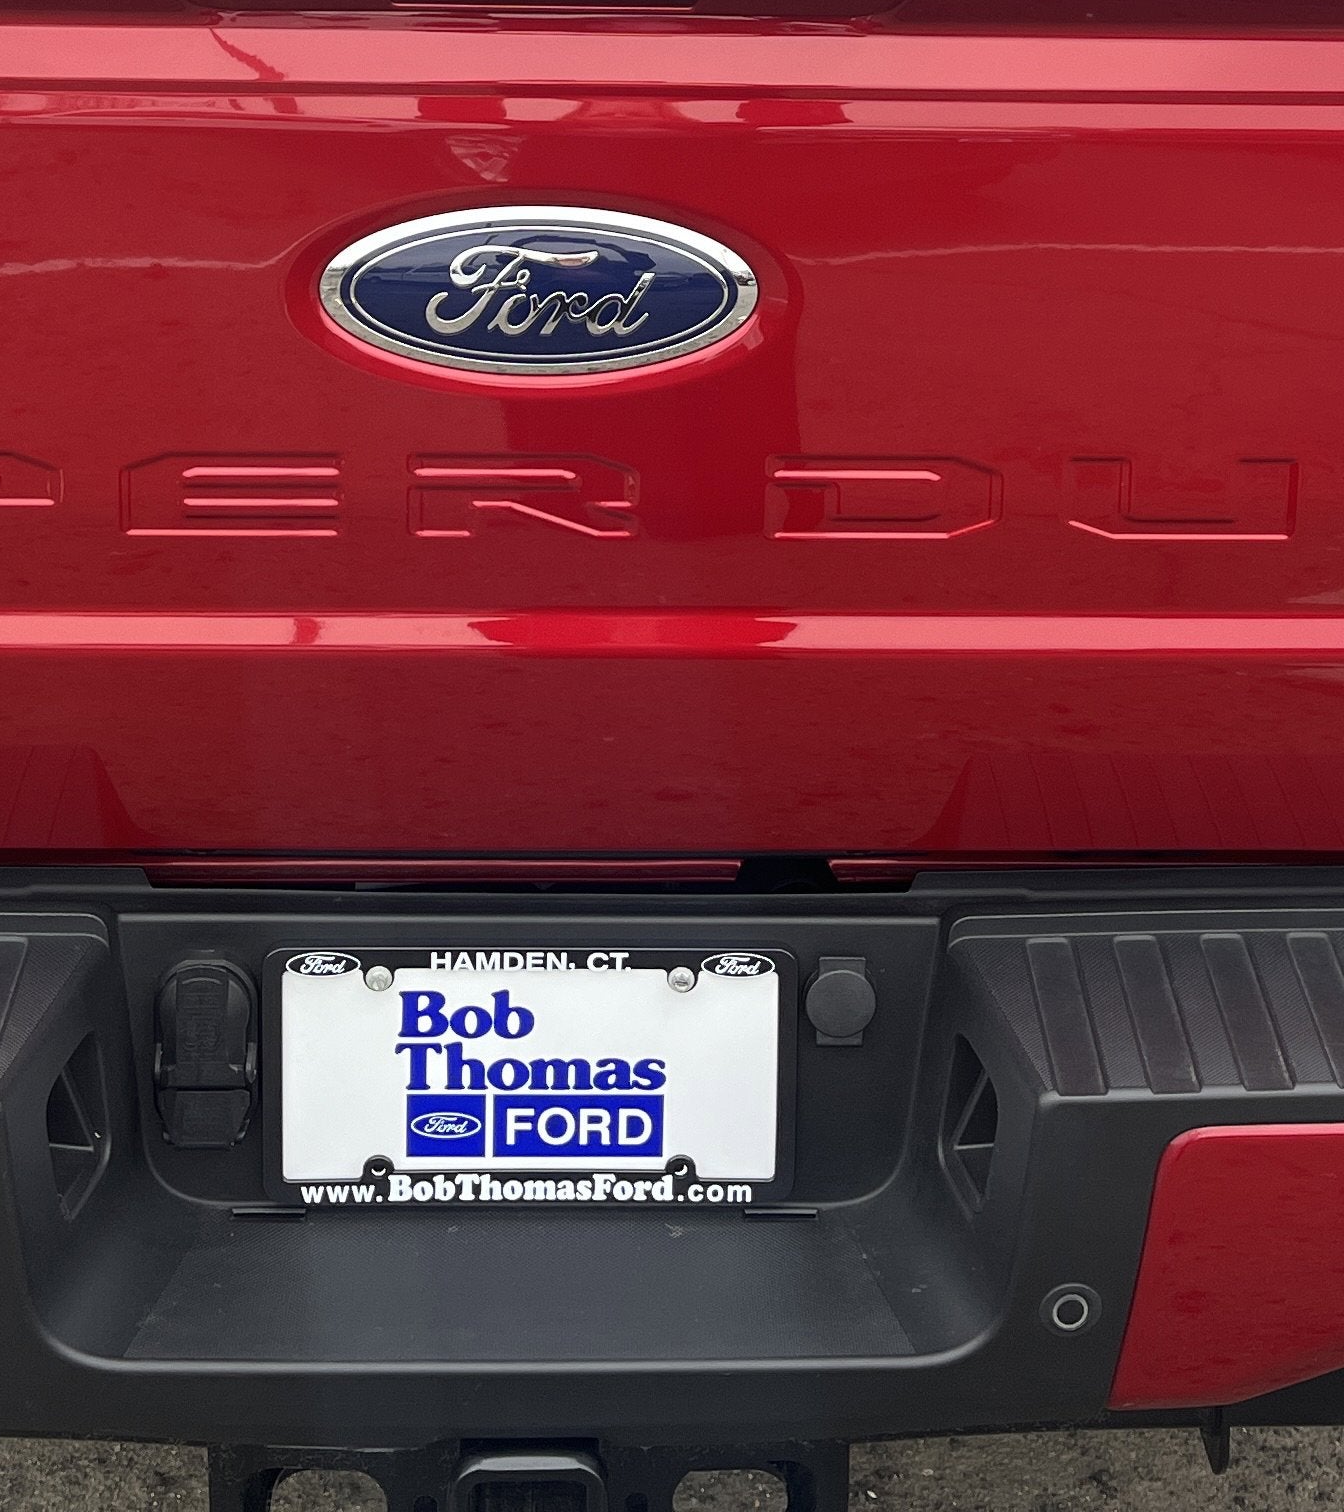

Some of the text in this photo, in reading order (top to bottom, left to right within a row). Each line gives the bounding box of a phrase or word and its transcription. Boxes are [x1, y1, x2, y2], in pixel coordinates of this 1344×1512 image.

[425, 244, 656, 338] Ford
[299, 954, 346, 974] Ford
[430, 951, 632, 973] HAMDEN, CT.
[714, 956, 761, 975] Ford
[398, 989, 535, 1039] Bob
[395, 1041, 667, 1091] Thomas
[424, 1116, 468, 1134] Ford
[506, 1106, 653, 1146] FORD
[300, 1172, 753, 1204] www.BobThomasFord.com
